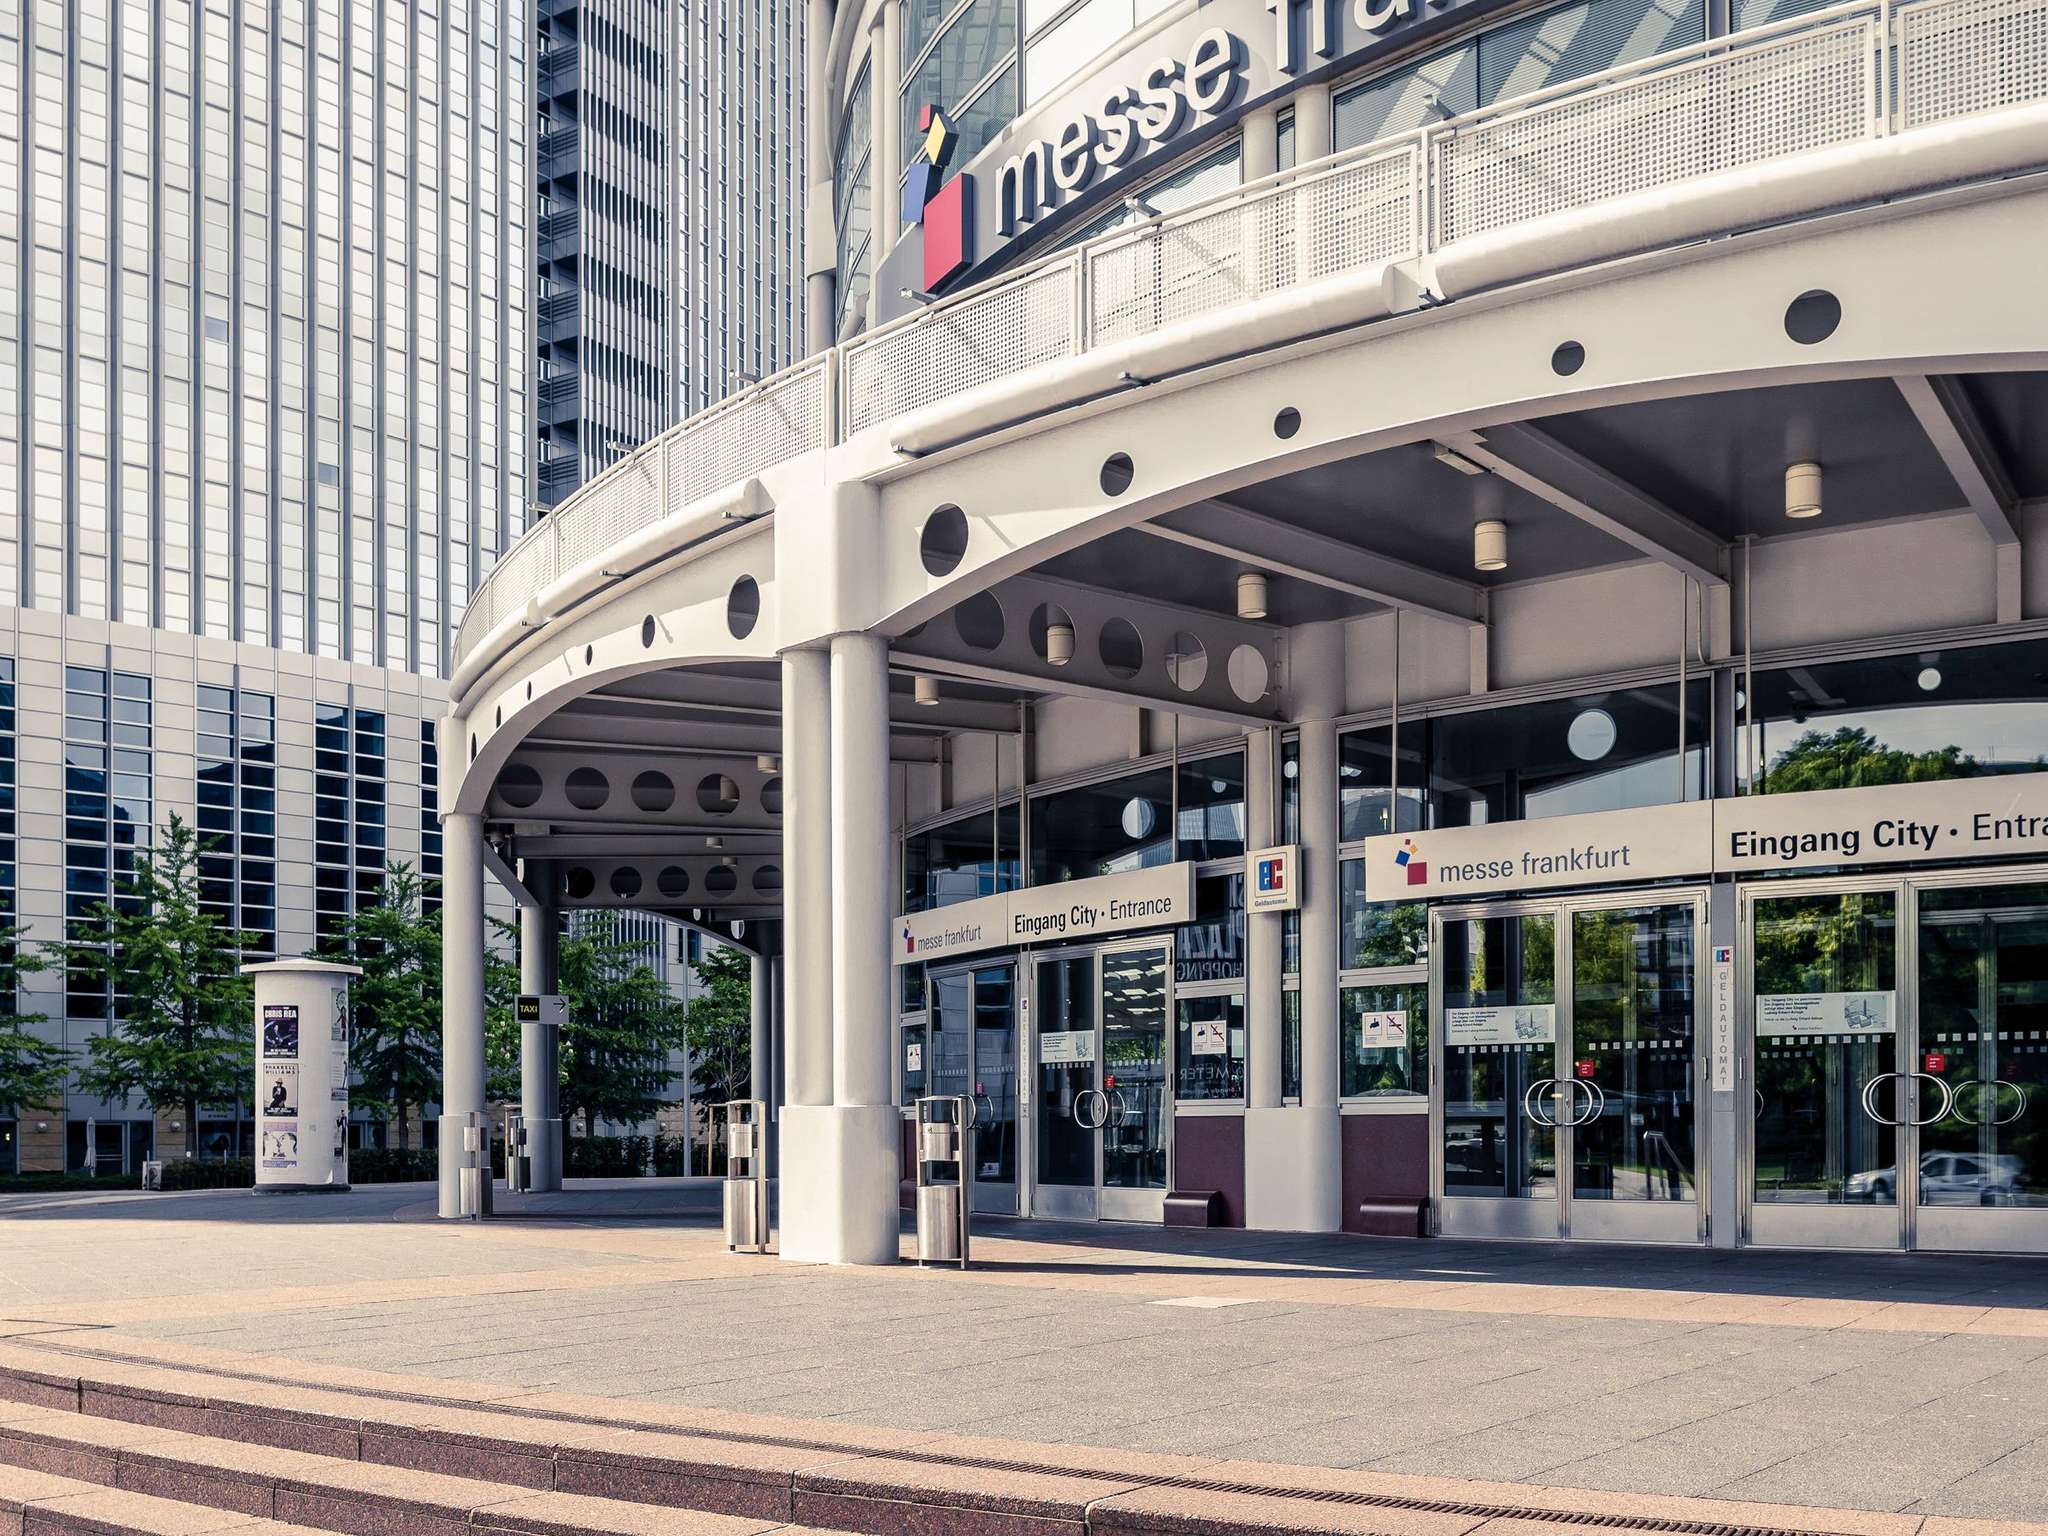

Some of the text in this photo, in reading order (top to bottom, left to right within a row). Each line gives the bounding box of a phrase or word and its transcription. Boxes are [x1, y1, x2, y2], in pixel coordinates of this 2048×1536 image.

[995, 27, 1241, 237] messe
[1730, 829, 1860, 861] Eingang
[1873, 819, 1939, 851] City
[1440, 844, 1631, 883] messe frankfurt
[1014, 897, 1172, 936] Eingang City Entrance
[917, 924, 982, 952] messe frankfurt
[519, 1004, 538, 1013] TAXI
[1719, 971, 1728, 1085] GELDAUTOMAT
